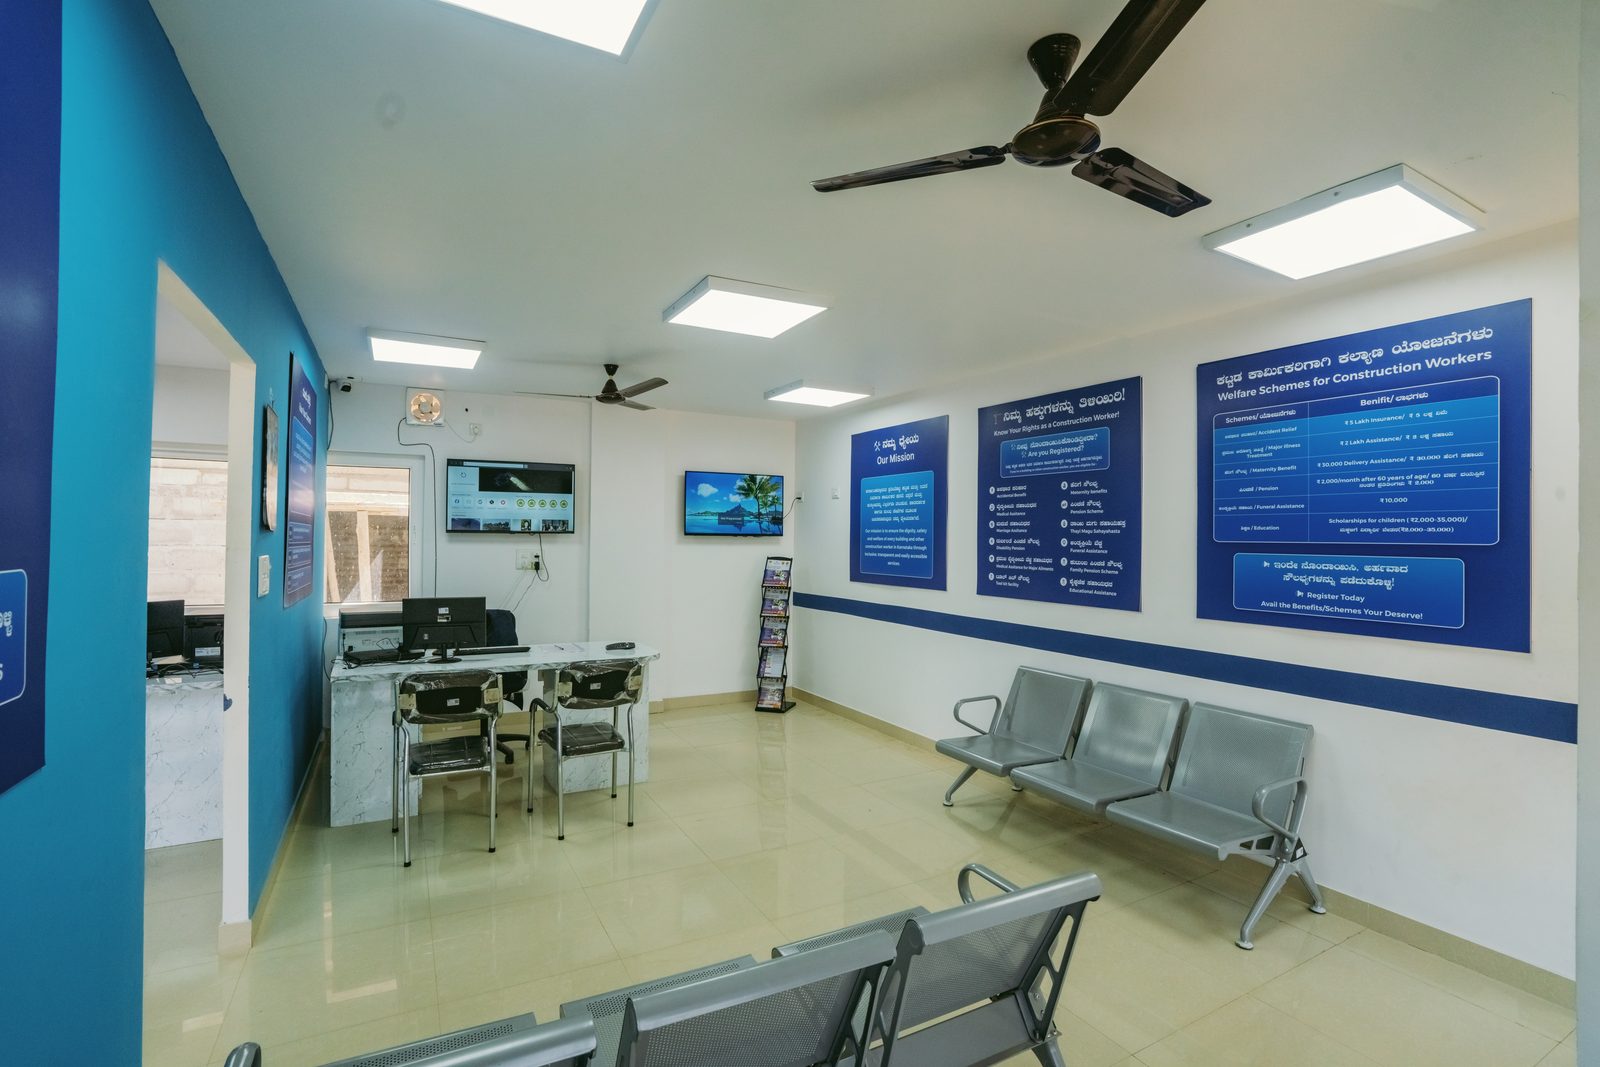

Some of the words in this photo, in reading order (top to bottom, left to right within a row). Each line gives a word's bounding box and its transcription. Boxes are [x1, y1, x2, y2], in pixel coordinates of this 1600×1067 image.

[1217, 372, 1242, 388] ಕಟ್ಟಡ
[1248, 357, 1331, 380] ಕಾರ್ಮಿಕರಿಗಾಗಿ
[1339, 348, 1383, 364] ಕಲ್ಯಾಣ
[1392, 327, 1493, 355] ಯೋಜನೆಗಳು
[1218, 387, 1256, 401] Welfare
[1259, 381, 1310, 394] Schemes
[1313, 377, 1330, 386] for
[1333, 361, 1421, 383] Construction
[1425, 351, 1492, 368] Workers
[1003, 410, 1022, 423] ನಿಮ್ಮ
[1053, 416, 1092, 427] Construction
[1093, 411, 1119, 421] Worker!
[882, 439, 896, 451] ನಮ್ಮ
[1049, 444, 1084, 455] Registered?
[877, 456, 888, 464] Our
[890, 452, 914, 463] Mission
[1307, 592, 1339, 600] Register
[1341, 594, 1365, 603] Today
[1292, 602, 1362, 616] Benefits/Schemes
[1385, 610, 1423, 619] Deserve!
